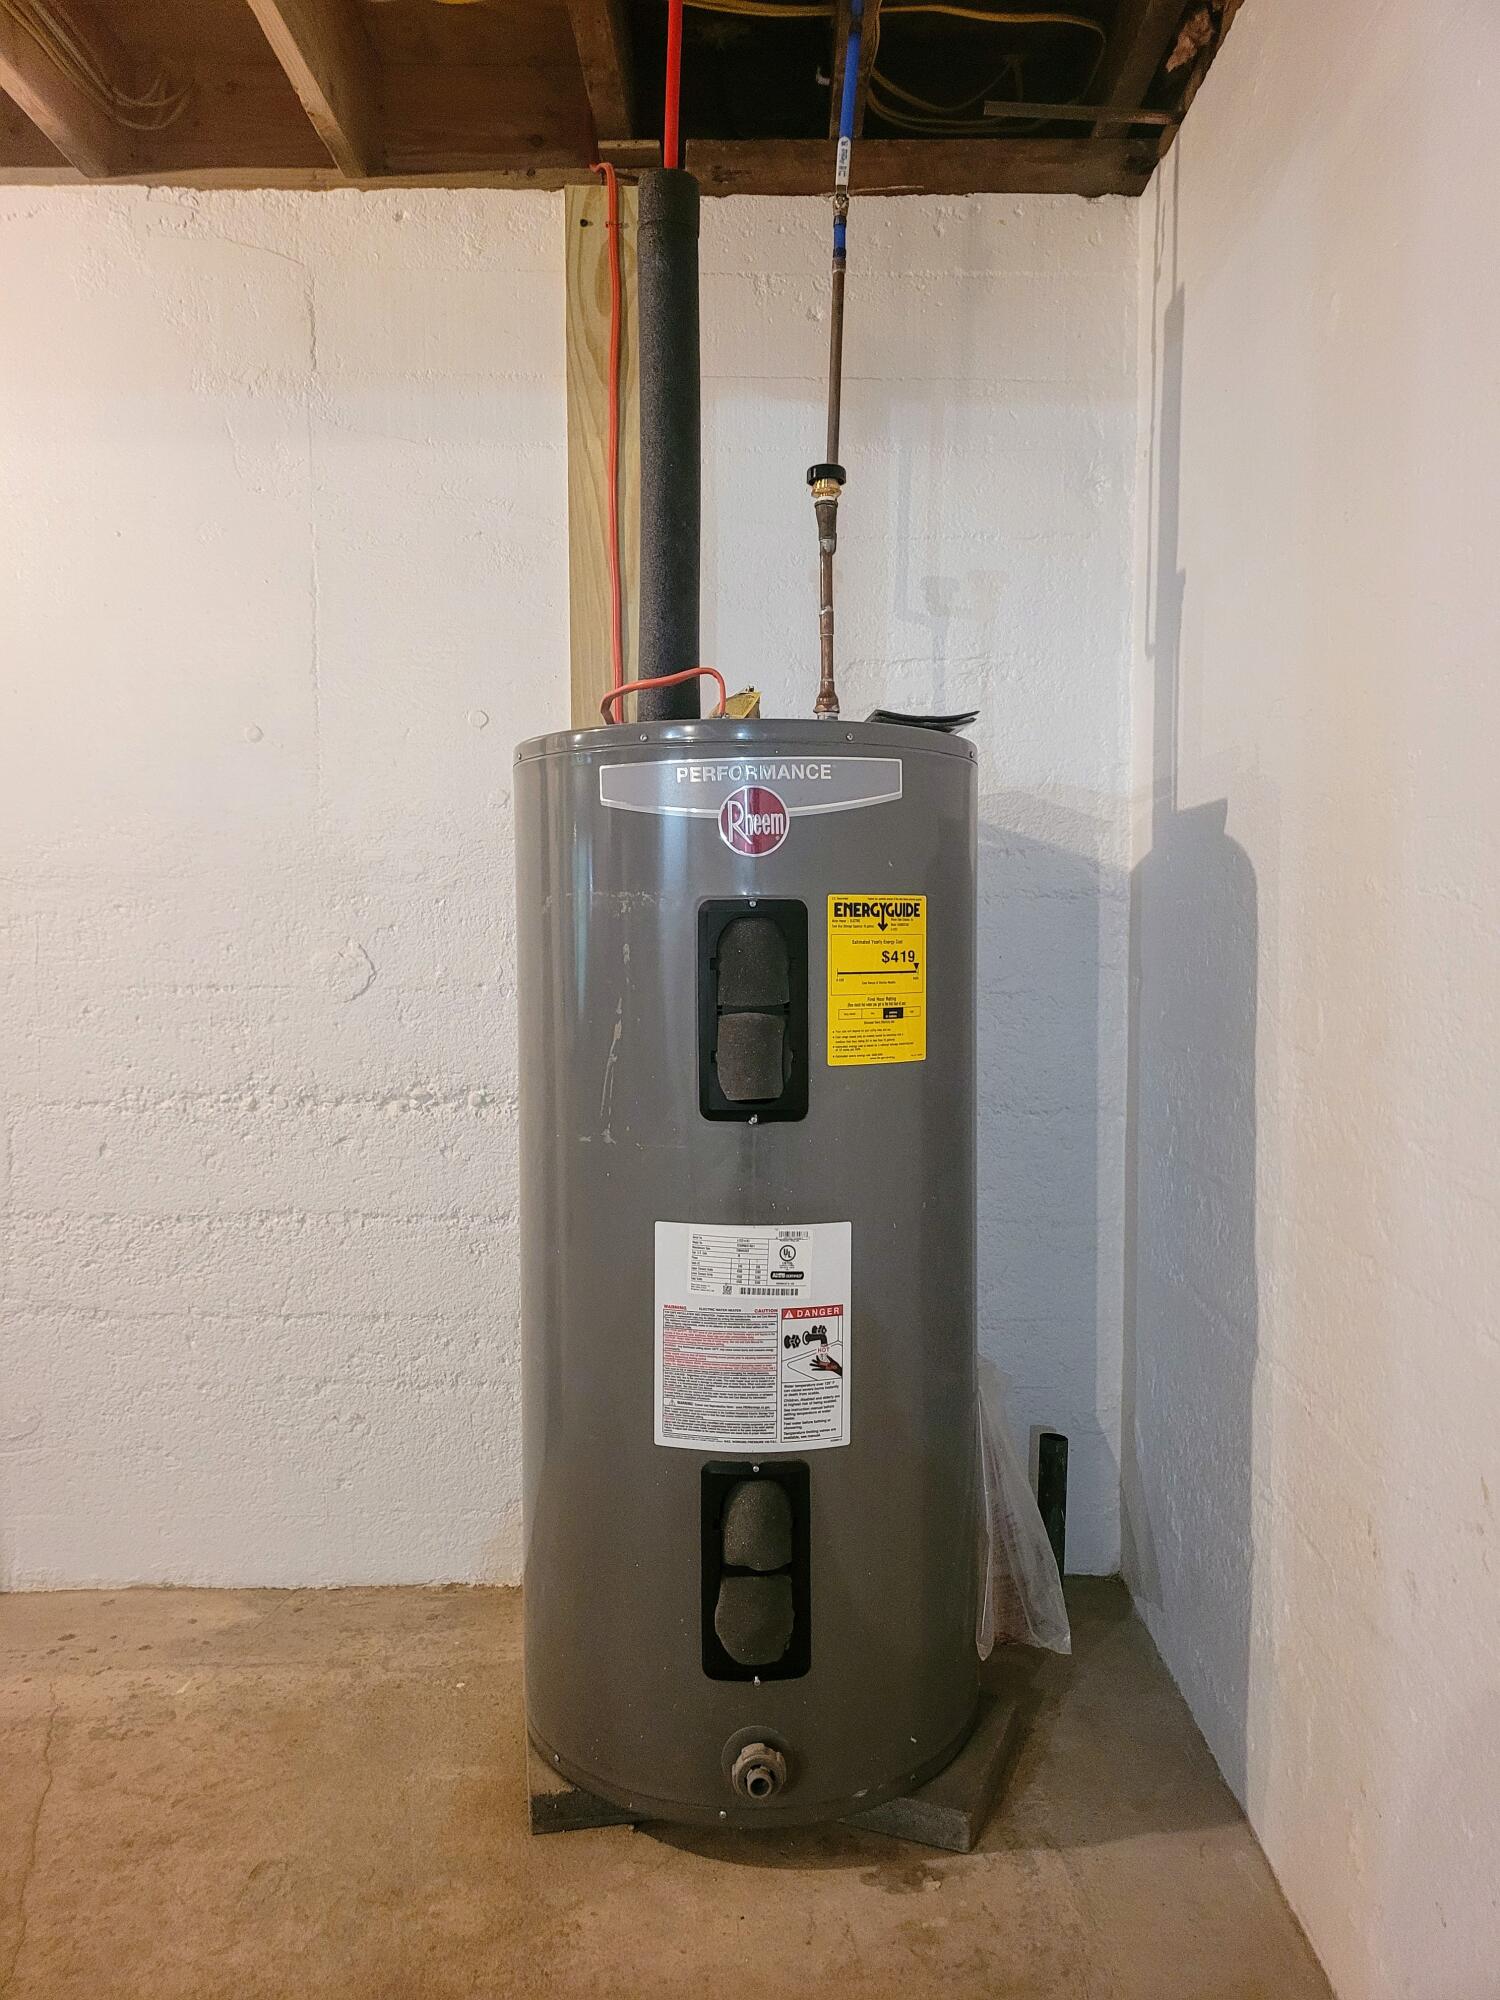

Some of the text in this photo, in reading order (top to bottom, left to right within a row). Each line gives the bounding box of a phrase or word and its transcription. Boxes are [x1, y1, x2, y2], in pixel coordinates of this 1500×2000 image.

[676, 764, 832, 783] PERFORMANCE
[727, 799, 785, 844] Rheem
[834, 902, 920, 918] ENERGYGUIDE
[881, 950, 915, 964] $419
[796, 1306, 840, 1318] DANGER
